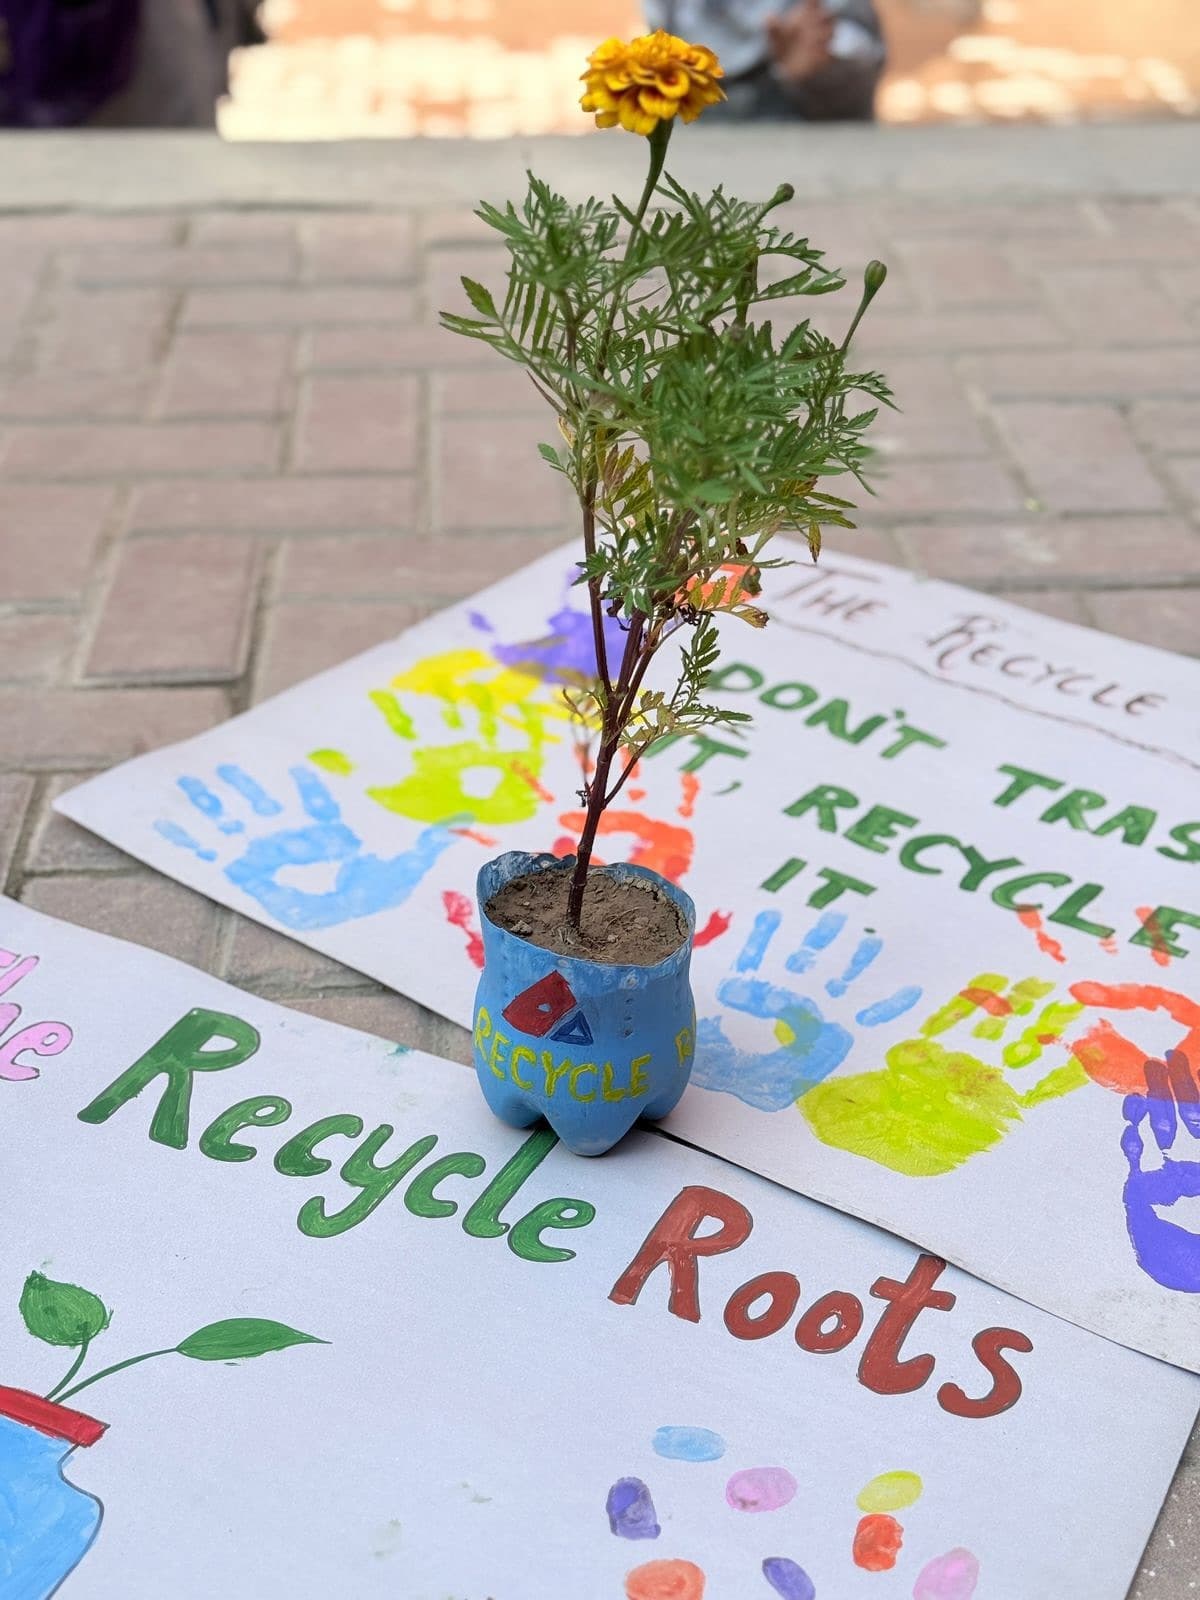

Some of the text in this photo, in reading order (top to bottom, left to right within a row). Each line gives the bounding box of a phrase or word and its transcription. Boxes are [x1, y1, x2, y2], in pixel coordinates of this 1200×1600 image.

[700, 661, 947, 760] DON'T
[770, 568, 1168, 716] THE RECYCLE
[782, 784, 1200, 959] RECYCLE
[473, 1007, 652, 1104] RECYCLE
[77, 1007, 597, 1263] Recycle
[607, 1185, 1034, 1419] Roots
